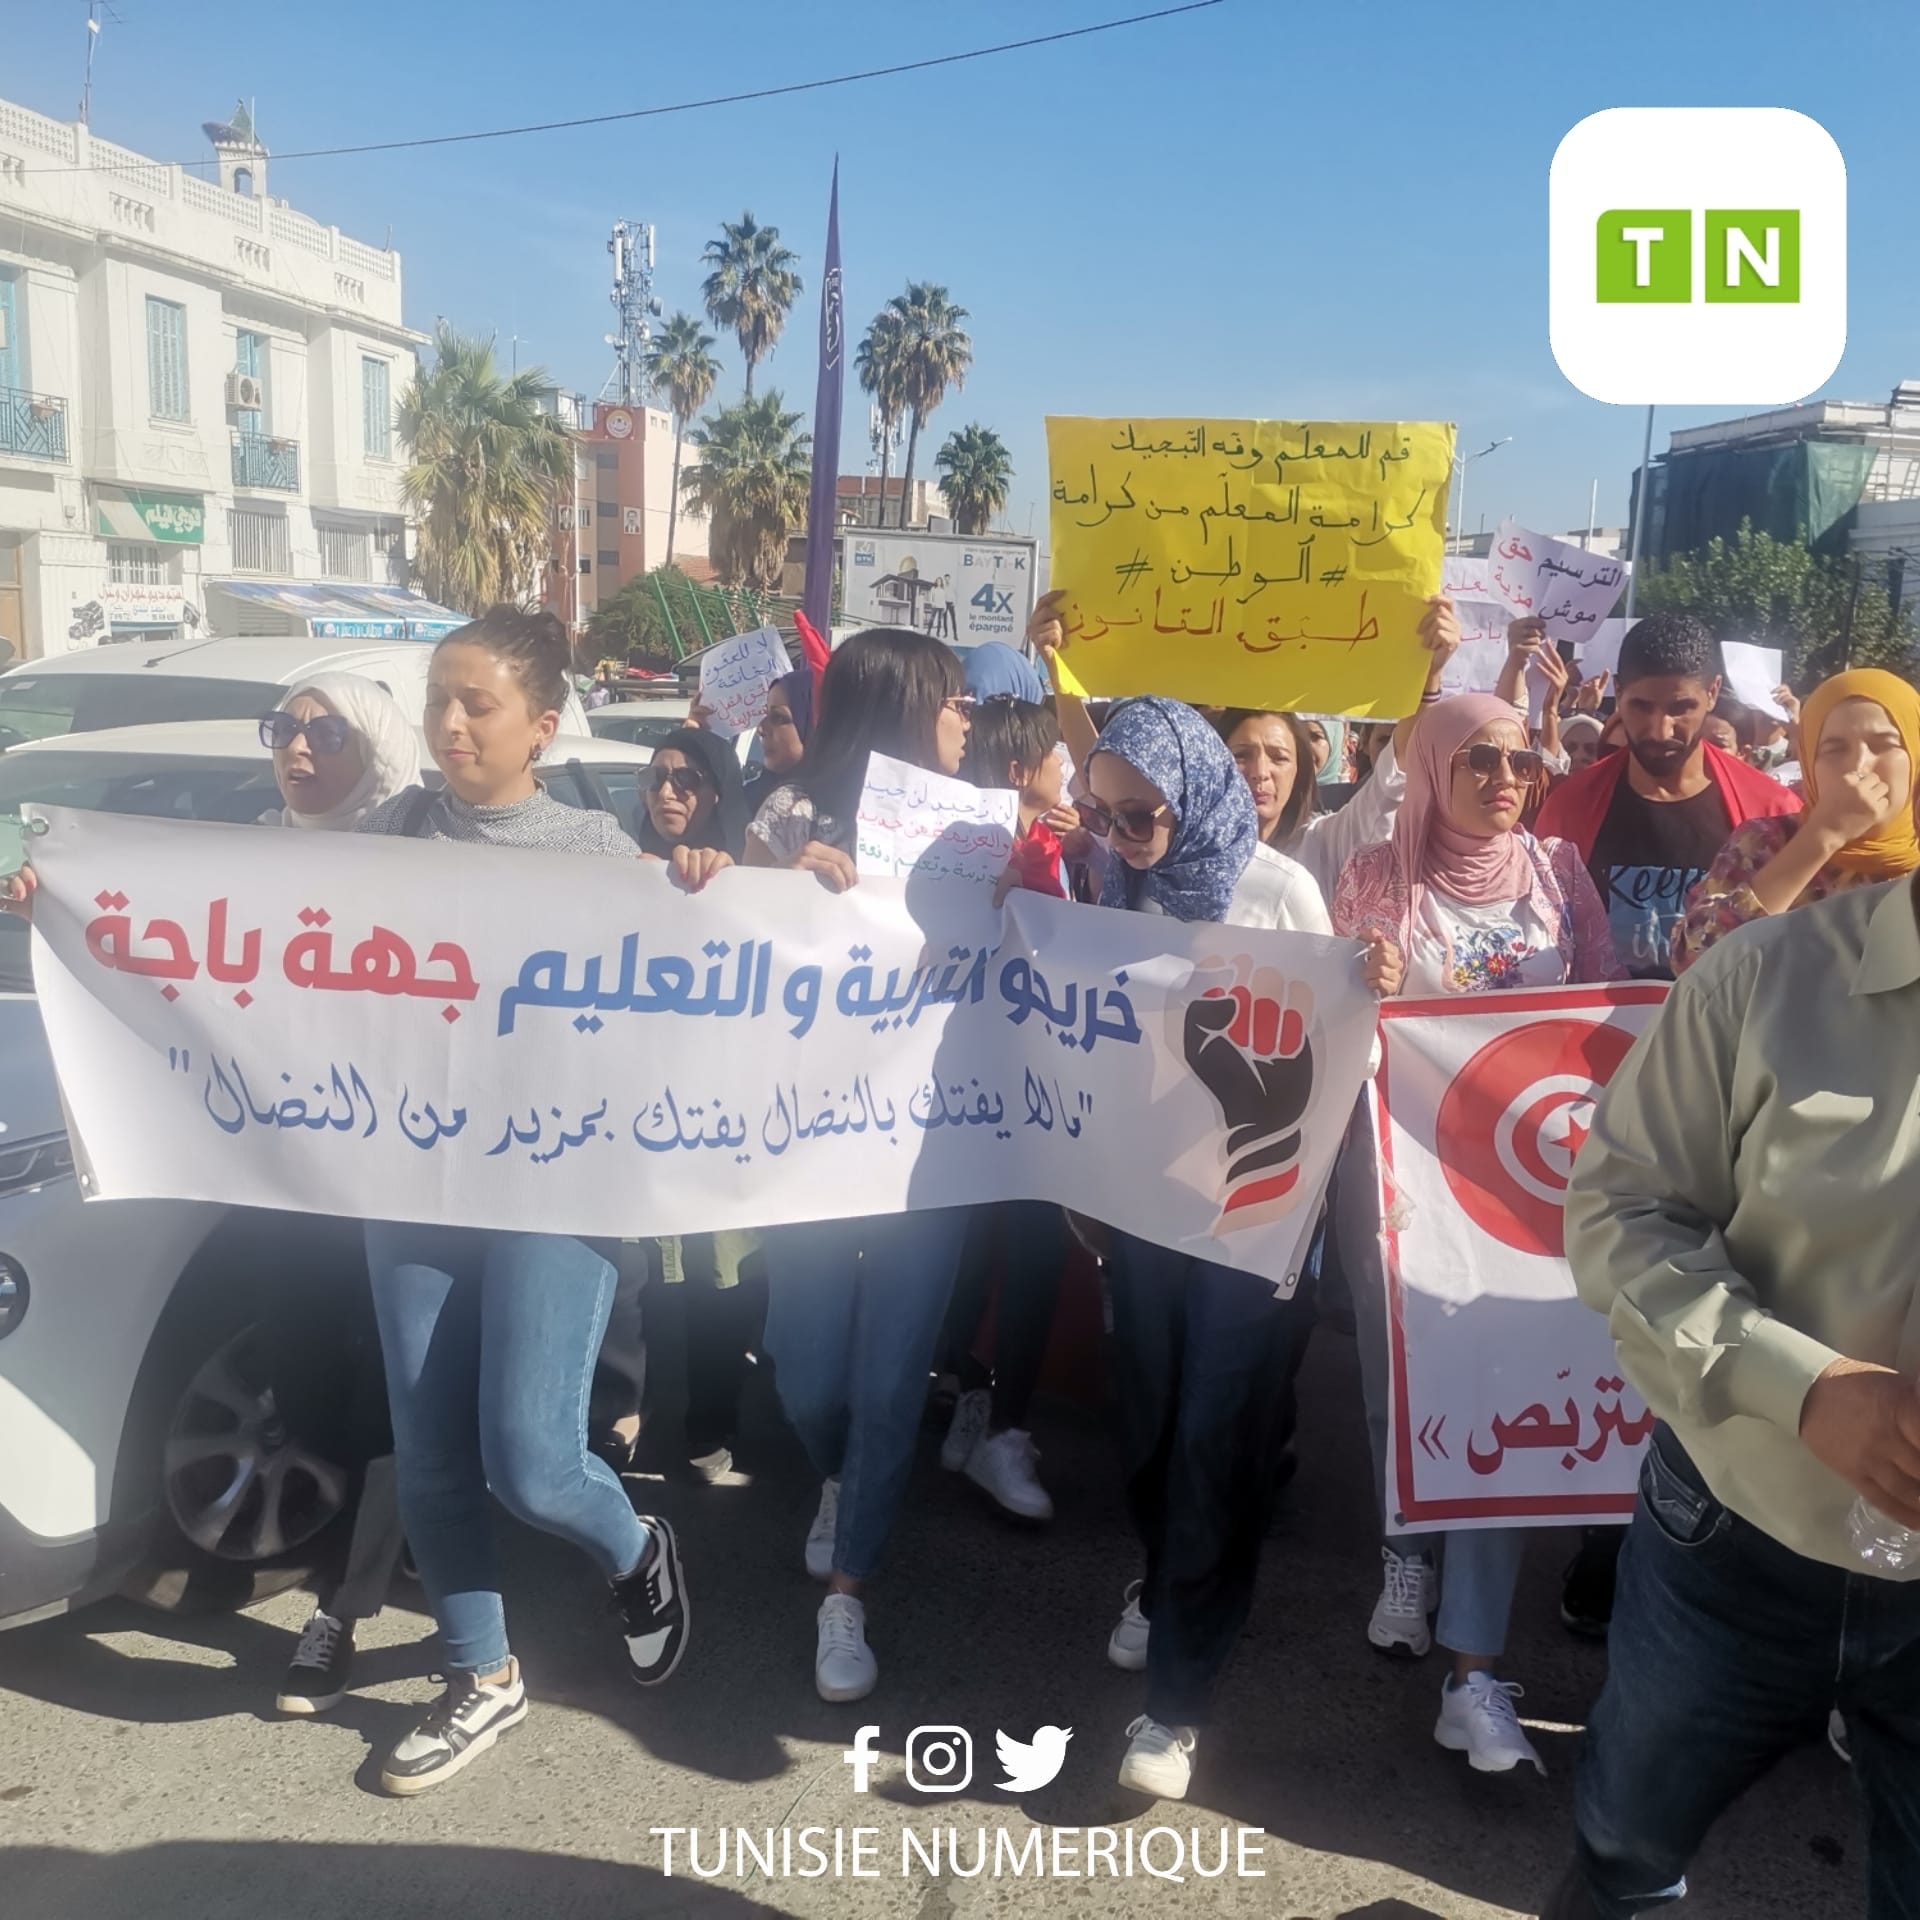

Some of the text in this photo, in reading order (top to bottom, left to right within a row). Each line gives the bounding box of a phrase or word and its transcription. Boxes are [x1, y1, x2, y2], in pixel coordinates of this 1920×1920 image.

[1379, 436, 1411, 482] قم
[1052, 463, 1137, 528] كرامة
[1145, 499, 1190, 521] من
[1308, 488, 1427, 546] كرامة
[1499, 537, 1534, 563] حق
[969, 622, 1014, 633] épargné
[1538, 600, 1597, 625] موش
[84, 888, 263, 1010] باجة
[282, 904, 481, 1025] جهة
[399, 1082, 468, 1151] من
[483, 1097, 616, 1165] بمزيد
[632, 1084, 752, 1165] يفتك
[761, 1072, 900, 1157] بالنضال
[908, 1070, 1013, 1141] يفتك
